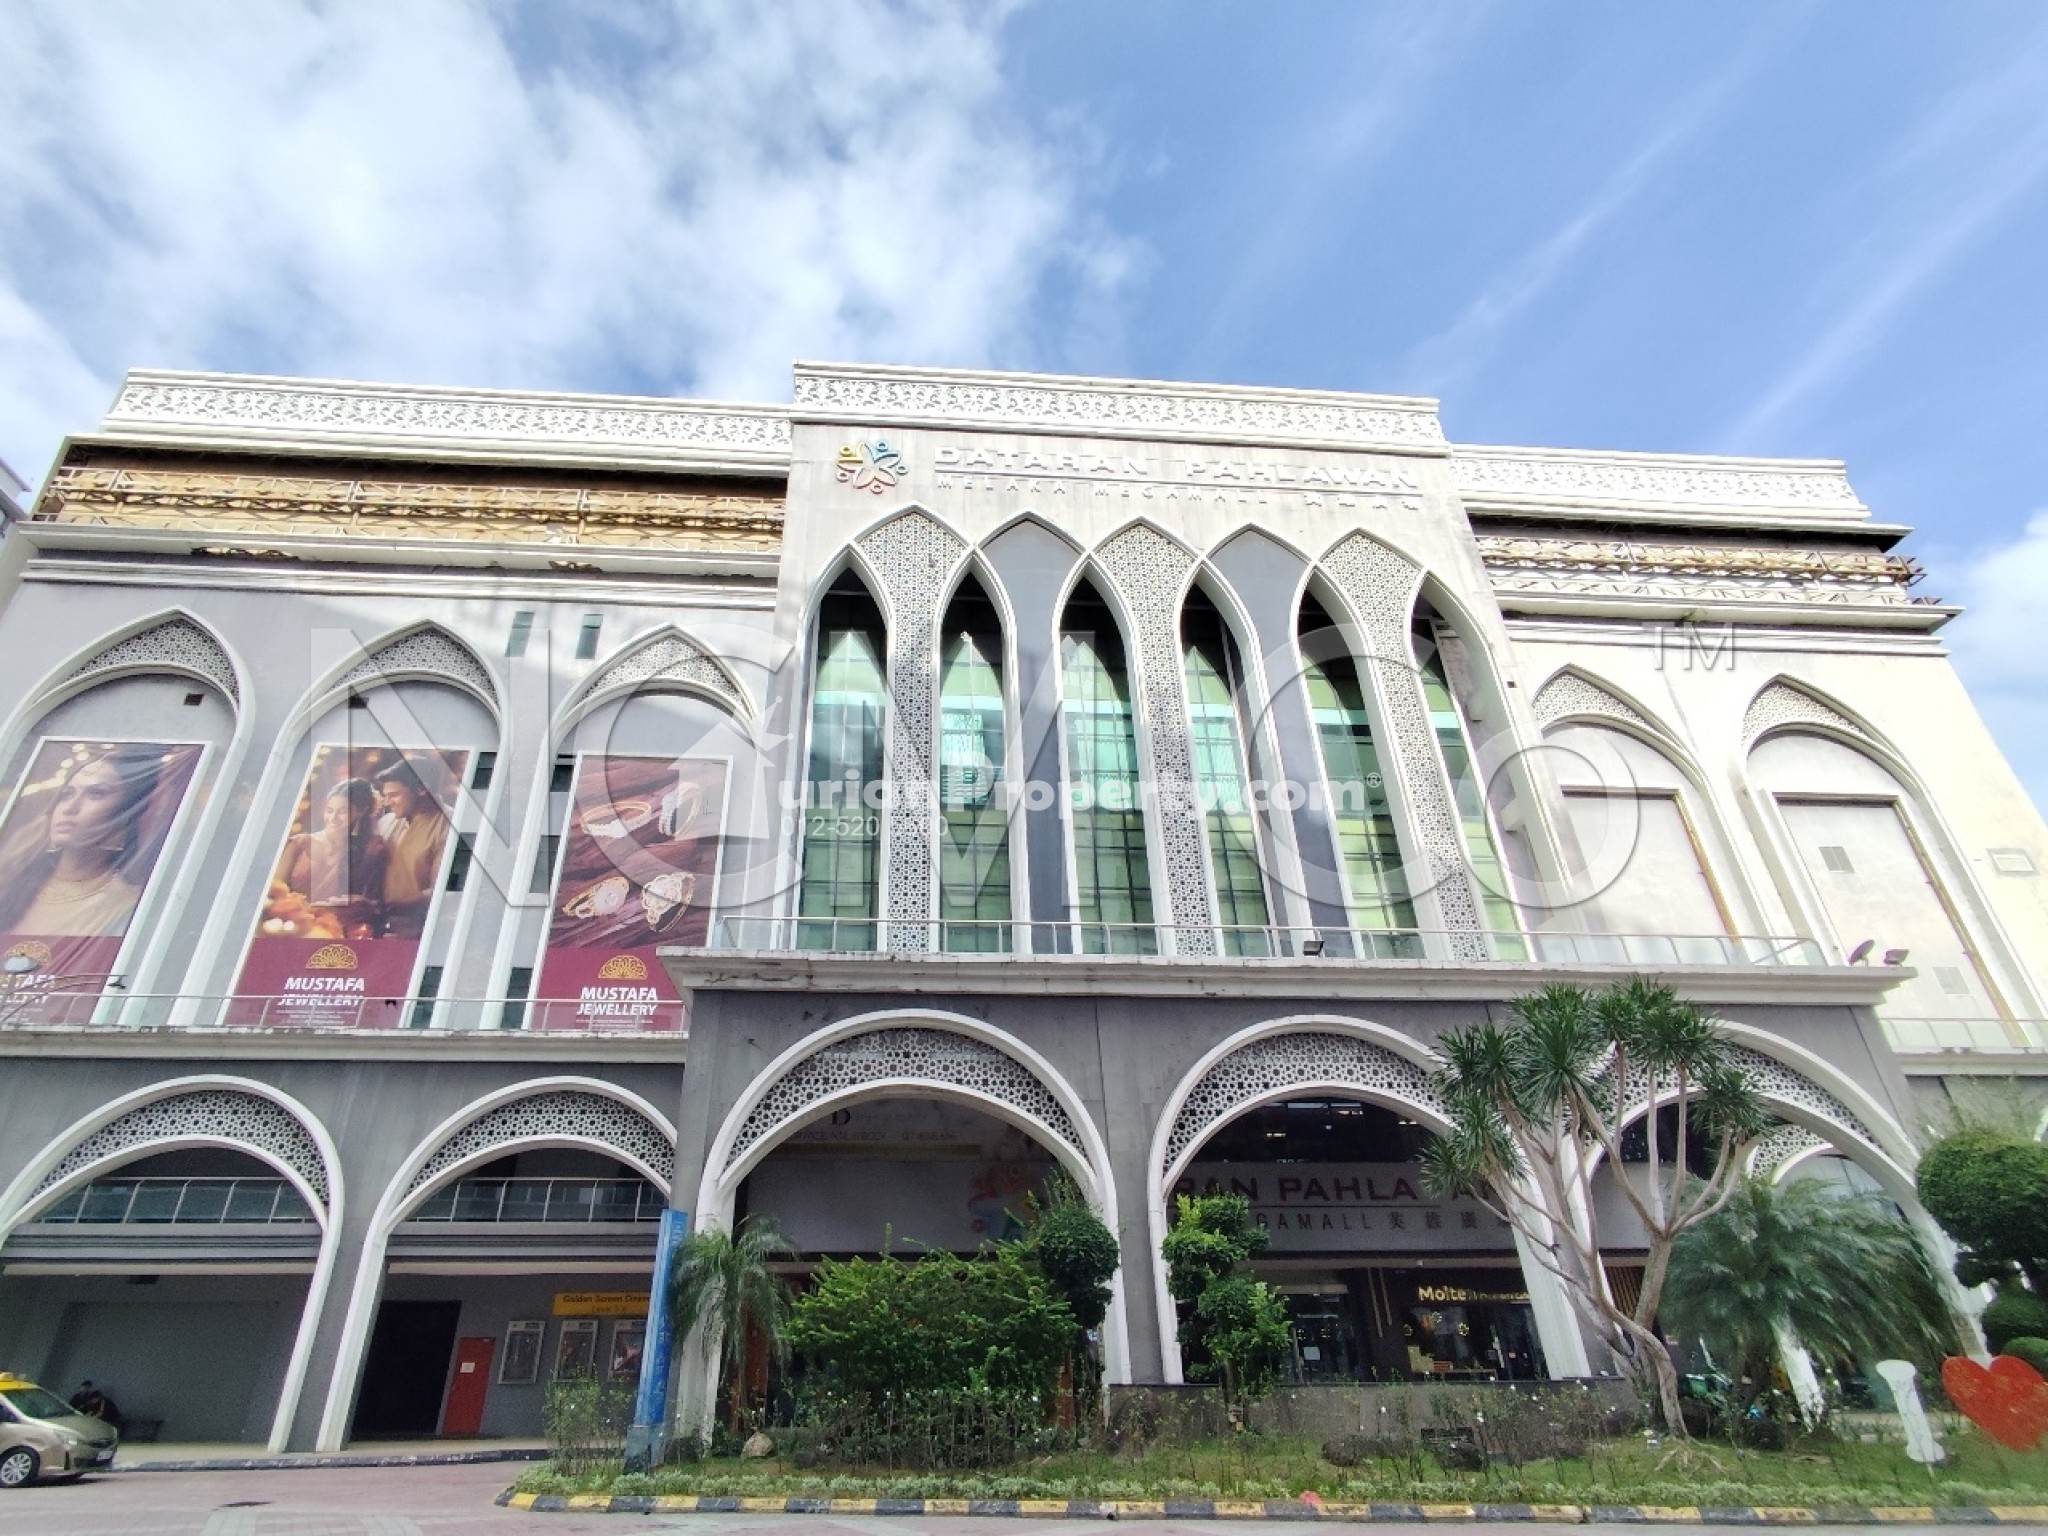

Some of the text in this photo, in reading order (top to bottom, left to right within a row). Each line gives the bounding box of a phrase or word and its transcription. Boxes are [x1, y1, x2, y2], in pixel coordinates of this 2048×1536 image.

[935, 446, 1418, 488] DATARAN PAHLAWAN
[937, 475, 1268, 504] MELAKA MEGAMALL
[284, 977, 365, 992] MUSTAFA
[277, 993, 364, 1006] JEWELLERY
[580, 987, 658, 1001] MUSTAFA
[576, 1002, 658, 1016] JEWELLERY
[562, 1294, 593, 1303] Golden
[595, 1294, 623, 1303] Screen
